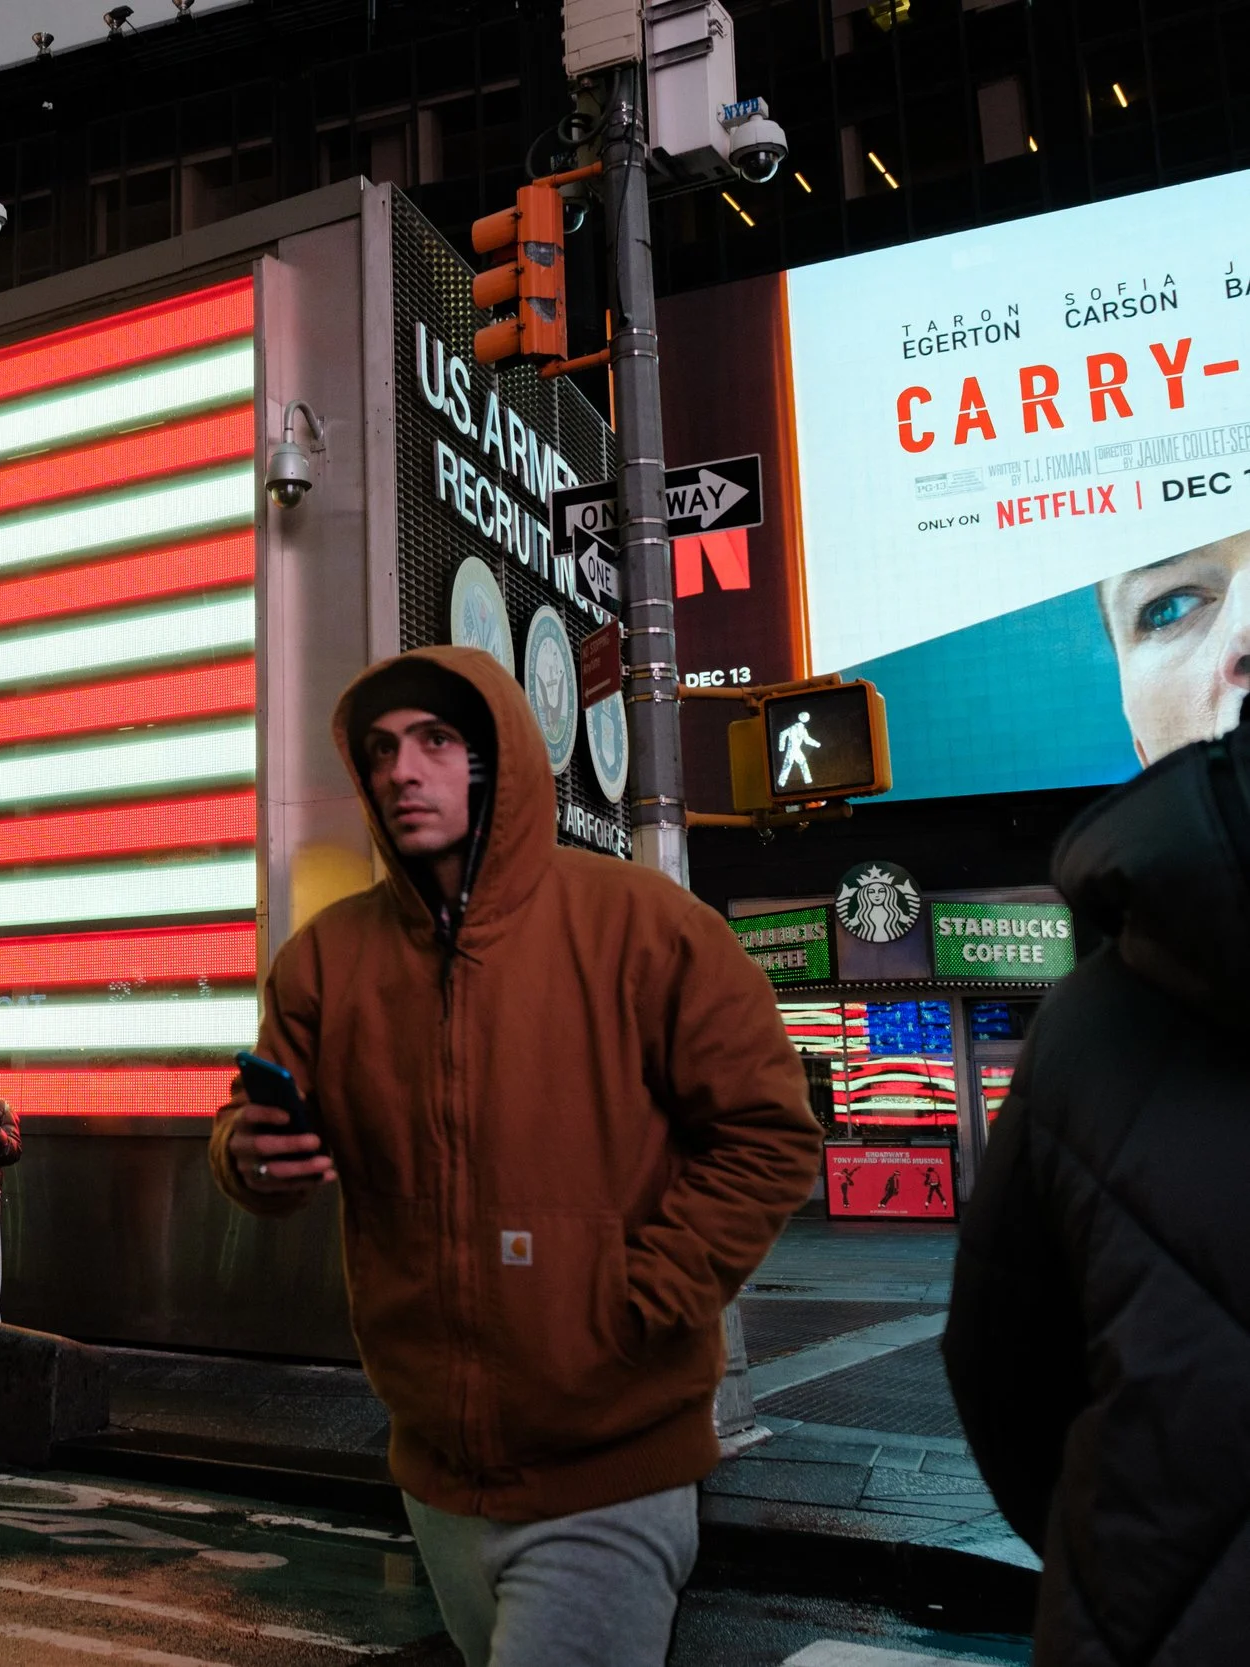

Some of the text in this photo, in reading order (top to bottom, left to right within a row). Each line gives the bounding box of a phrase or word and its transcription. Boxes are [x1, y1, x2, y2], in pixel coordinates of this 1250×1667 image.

[724, 97, 759, 120] NYPD
[1065, 273, 1175, 306] SOFIA
[1225, 278, 1250, 299] B
[902, 303, 1020, 337] TARON
[1065, 289, 1178, 329] CARSON
[903, 319, 1021, 359] EGERTON
[896, 337, 1240, 453] CARRY-
[416, 321, 579, 503] U.S. ARME
[1098, 443, 1133, 460] DIRECTED
[1123, 458, 1134, 469] BY
[1137, 436, 1181, 467] JAUME
[988, 460, 1022, 477] WRITTEN
[1011, 474, 1022, 487] BY
[1024, 450, 1091, 484] T.J. FIXMAN
[916, 481, 947, 494] PG-13
[918, 517, 955, 532] ONLY
[958, 513, 981, 526] ON
[996, 484, 1117, 530] NETFLIX
[1161, 471, 1232, 502] DEC
[582, 483, 727, 530] ON WAY
[433, 439, 589, 613] RECRUITIN
[587, 556, 613, 593] ONE
[685, 666, 751, 688] DEC 13
[738, 921, 827, 948] TARBUCKS
[938, 916, 1070, 939] STARBUCKS
[753, 949, 808, 971] OFFEE
[962, 943, 1045, 964] COFFEE
